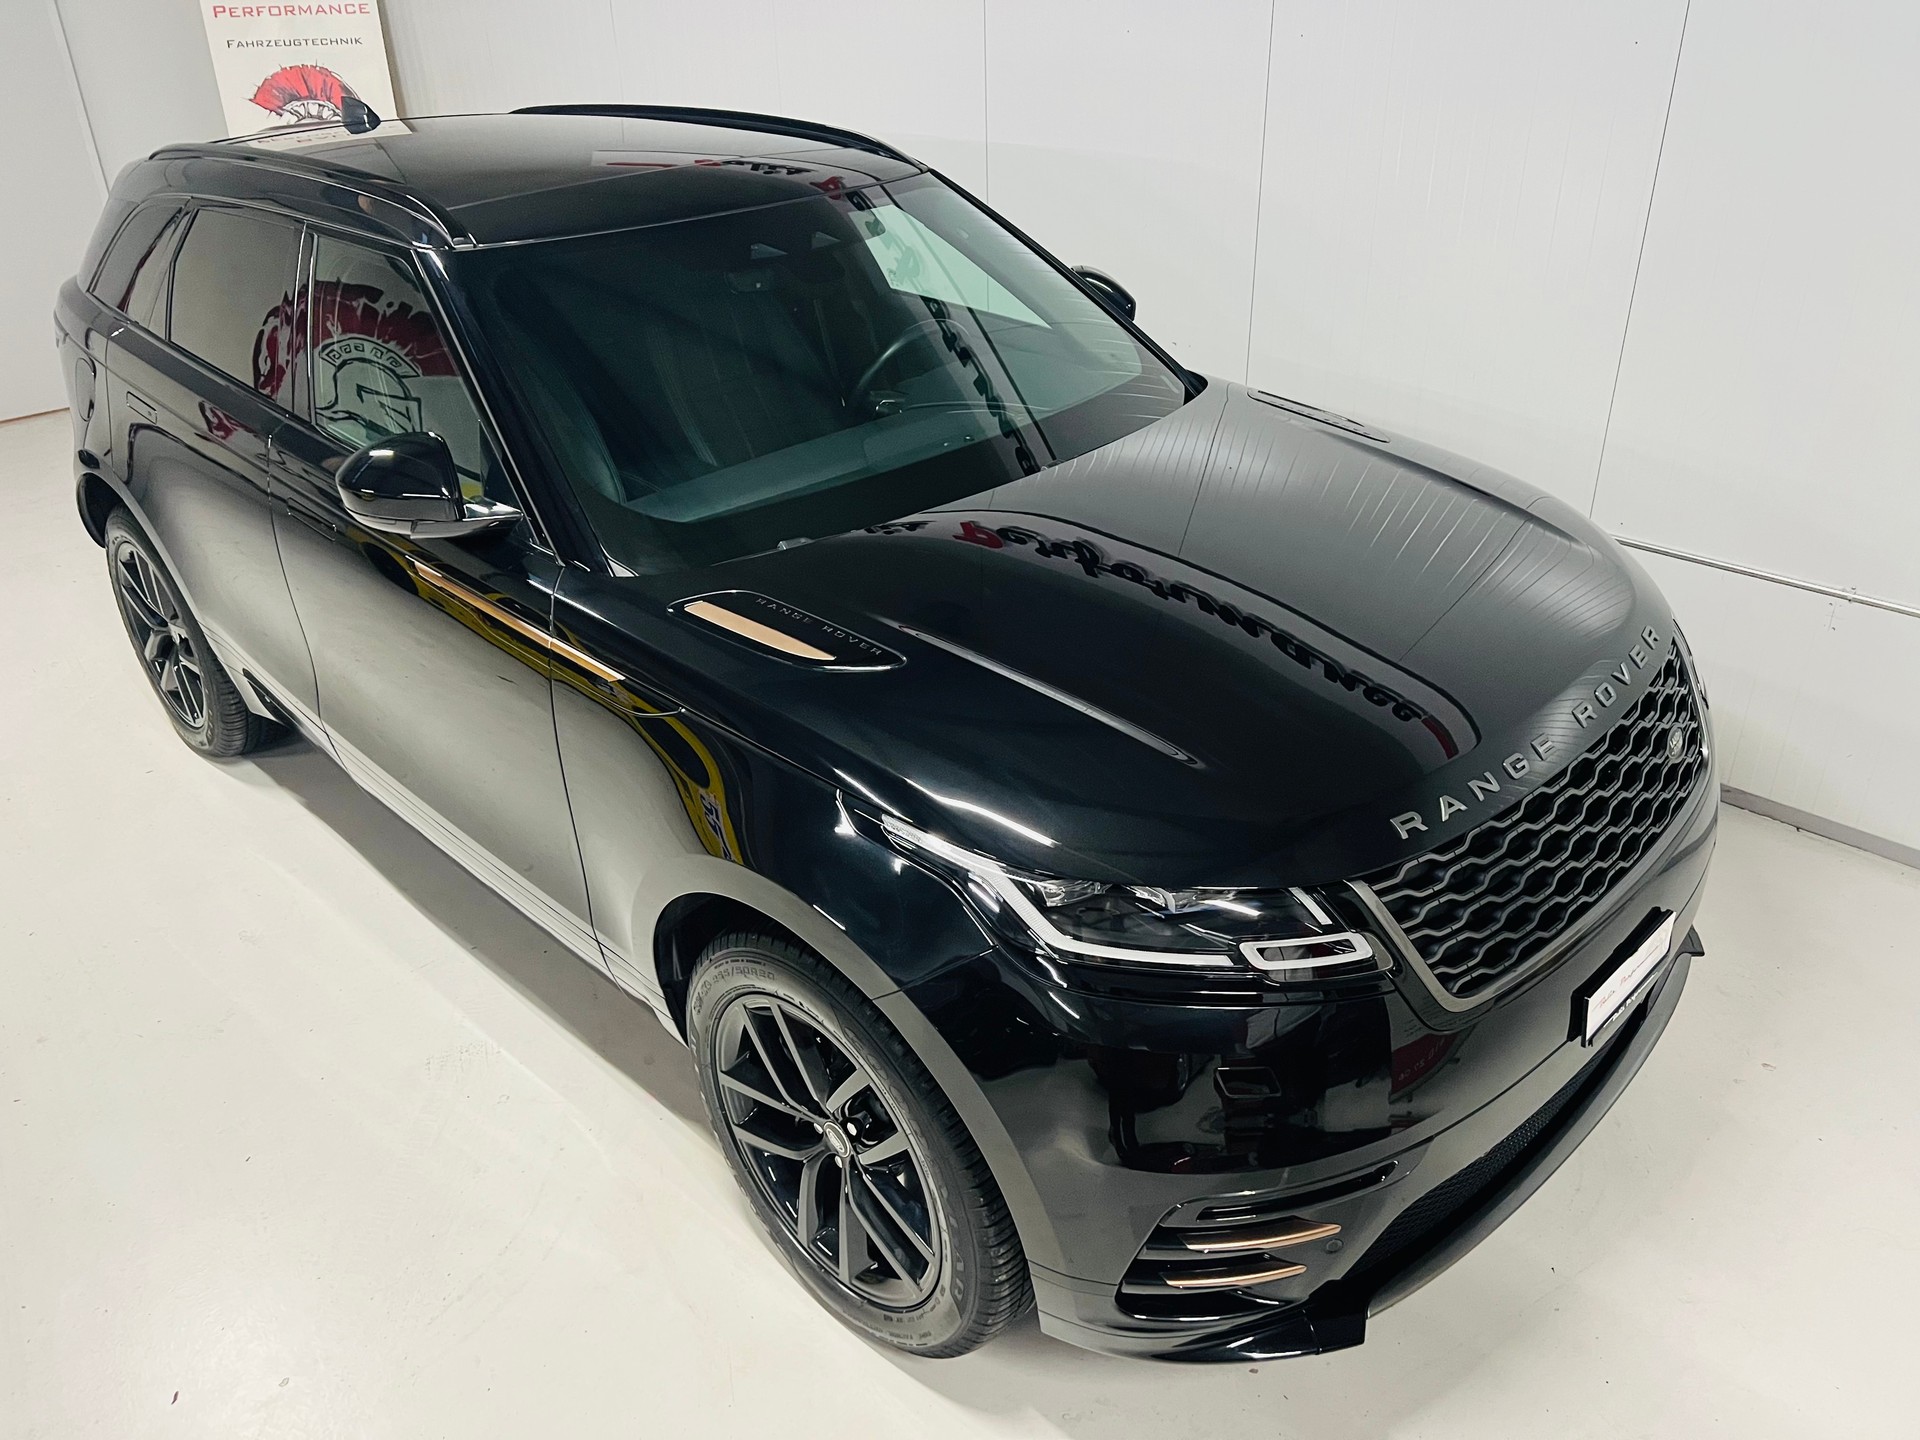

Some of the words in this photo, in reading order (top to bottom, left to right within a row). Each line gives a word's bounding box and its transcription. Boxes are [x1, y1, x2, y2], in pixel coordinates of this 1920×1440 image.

[213, 3, 370, 18] PERFORMANCE
[226, 37, 363, 48] FAHRZEUGTECHNIK
[755, 597, 812, 625] RANGE
[821, 625, 882, 656] ROVER
[1389, 732, 1554, 840] RANGE
[1571, 624, 1660, 728] ROVER
